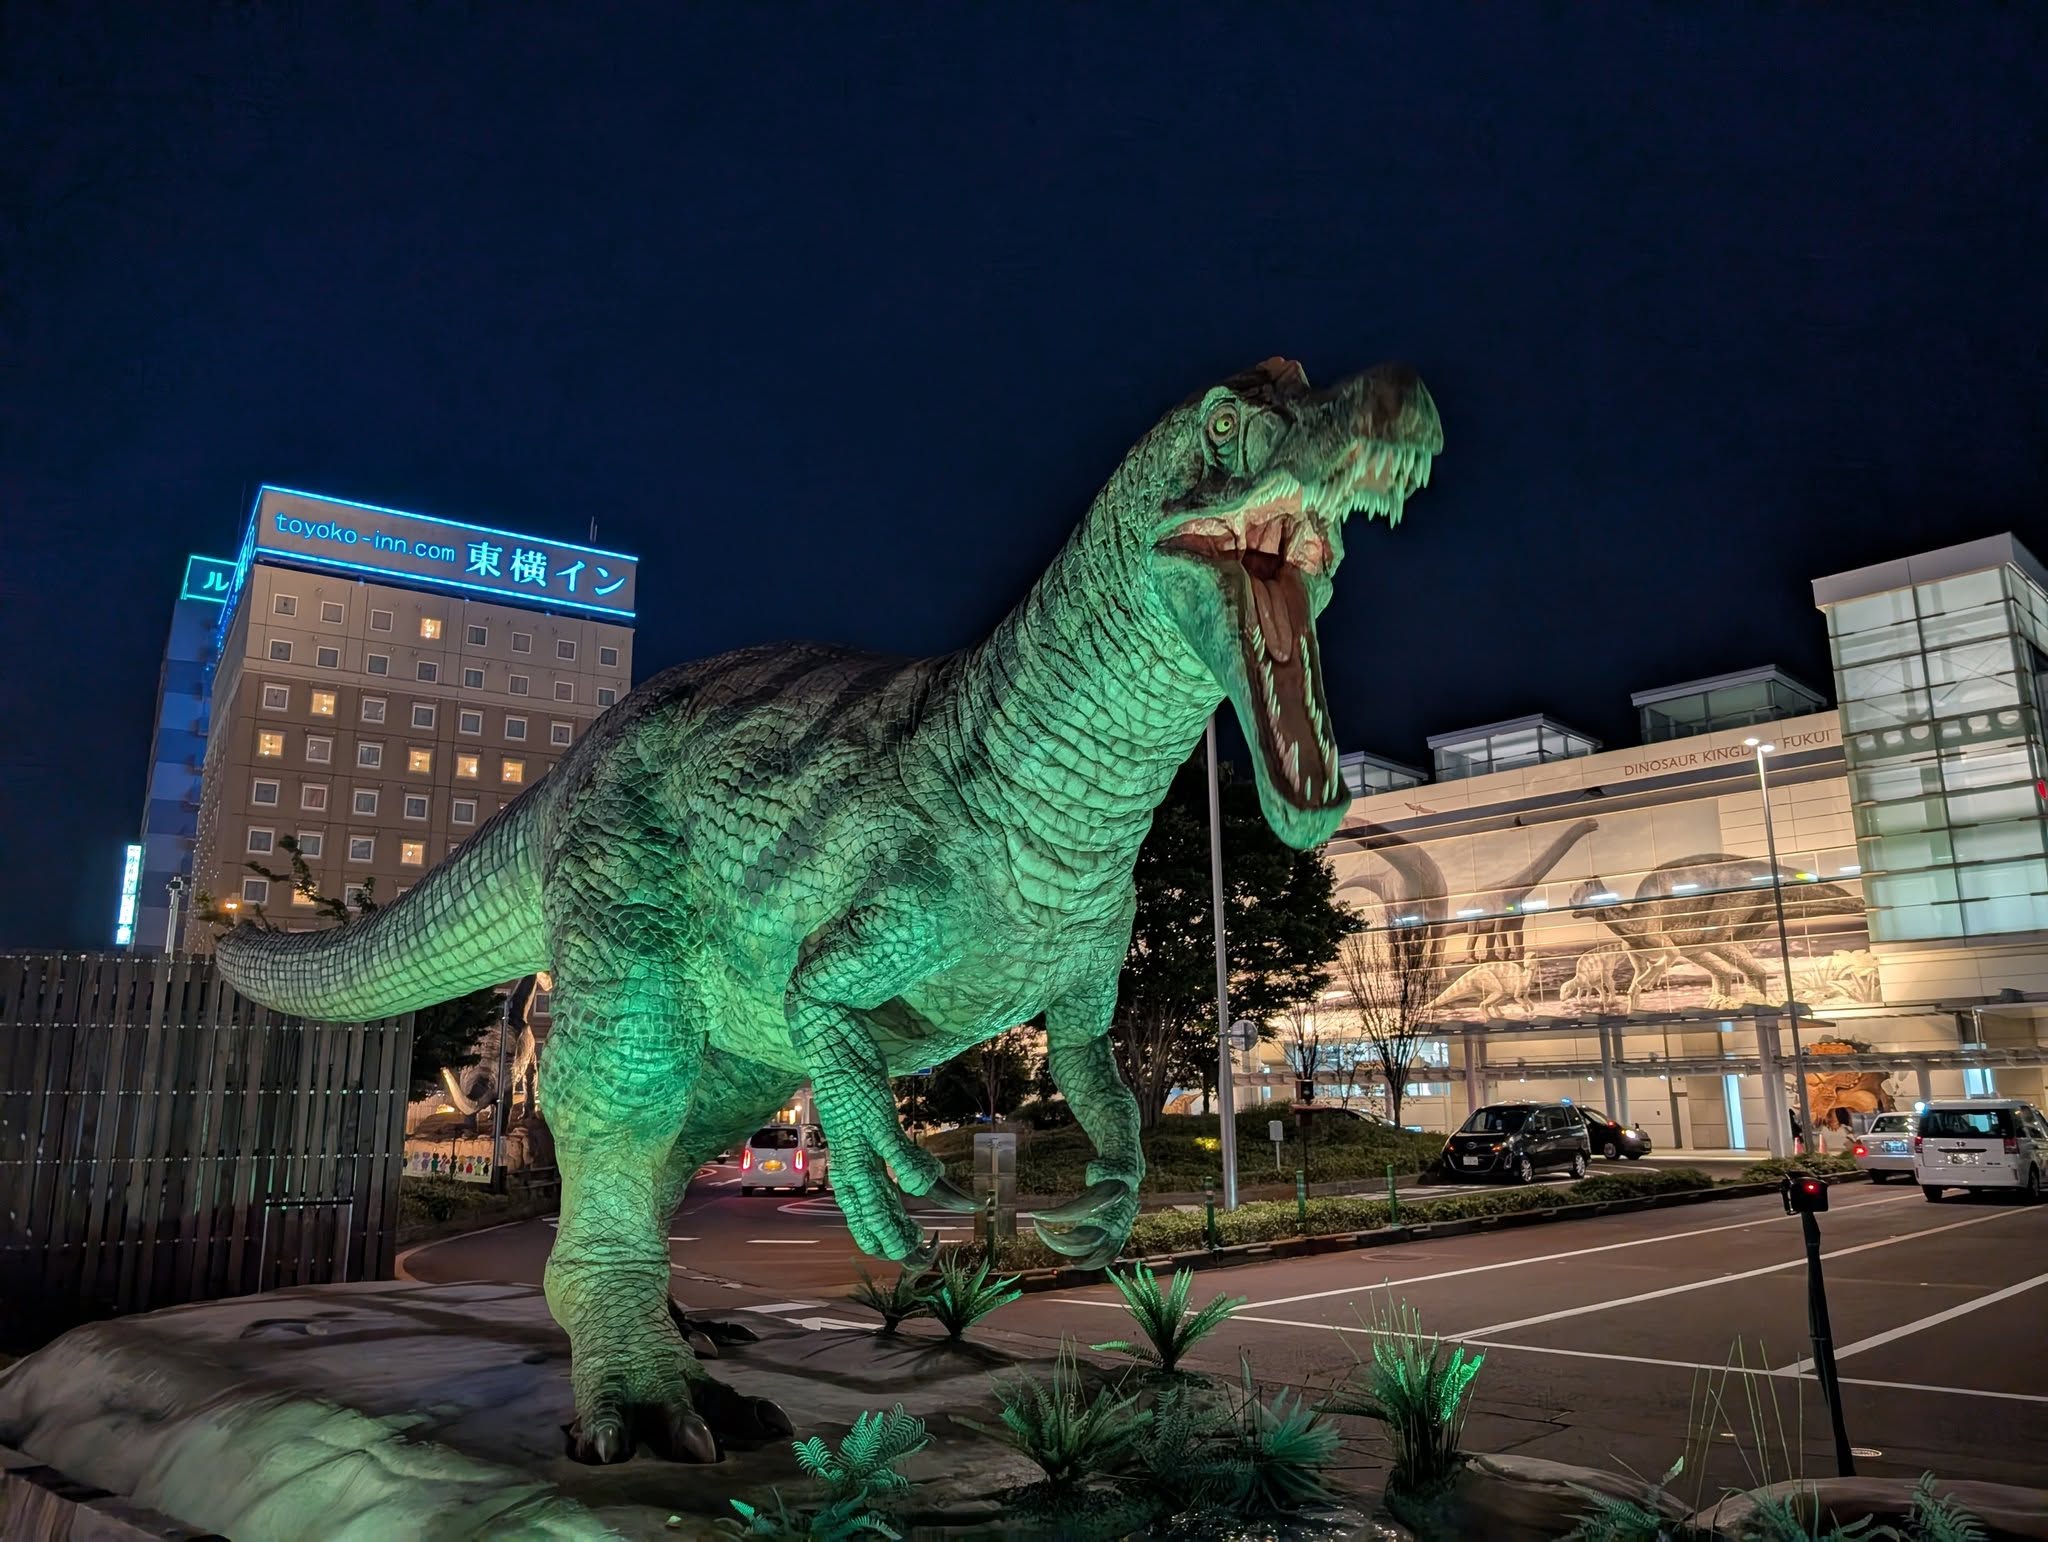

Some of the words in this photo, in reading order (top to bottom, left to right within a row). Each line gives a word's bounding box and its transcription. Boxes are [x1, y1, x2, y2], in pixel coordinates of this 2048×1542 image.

[275, 513, 455, 562] toyoko-inn.com
[465, 541, 625, 595] 東横イン
[1624, 753, 1698, 776] DINOSAUR
[1702, 739, 1776, 762] KINGD
[1782, 730, 1831, 749] FUKUI
